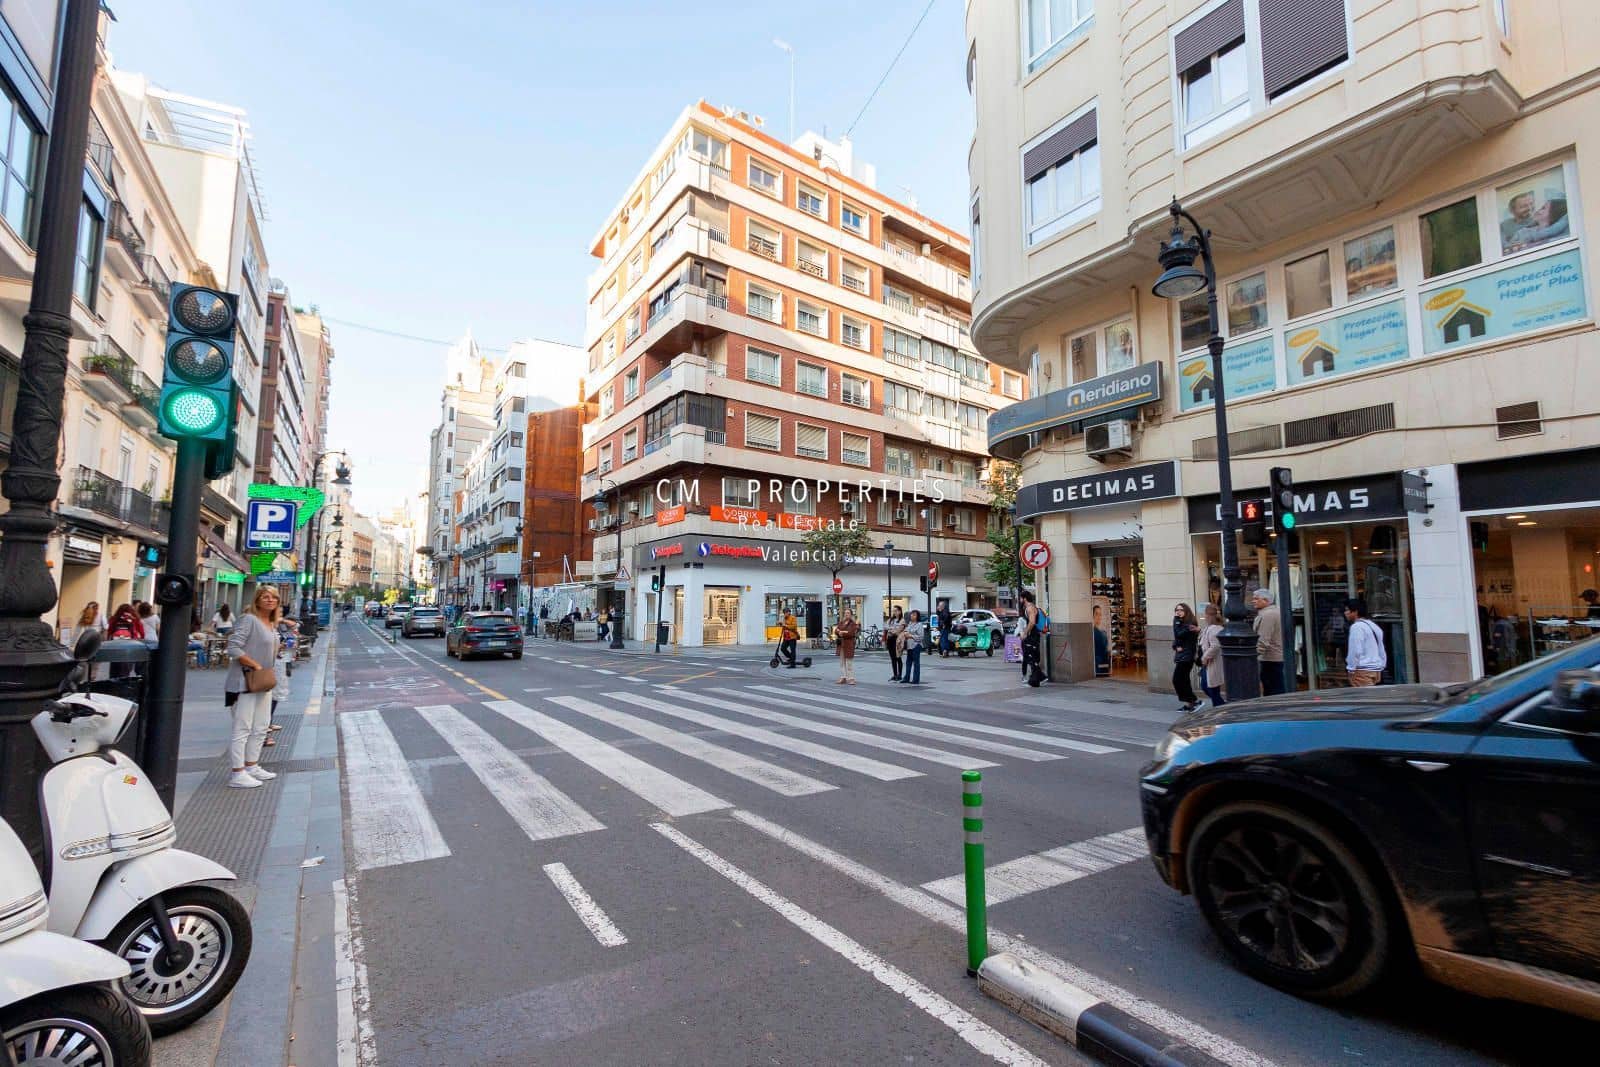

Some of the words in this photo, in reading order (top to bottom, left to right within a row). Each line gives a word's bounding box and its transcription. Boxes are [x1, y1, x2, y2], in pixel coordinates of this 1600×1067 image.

[1498, 263, 1572, 288] Protección
[1500, 281, 1543, 301] Hogar
[1548, 273, 1578, 289] Plus
[1052, 474, 1155, 503] DECIMAS
[256, 504, 287, 531] P
